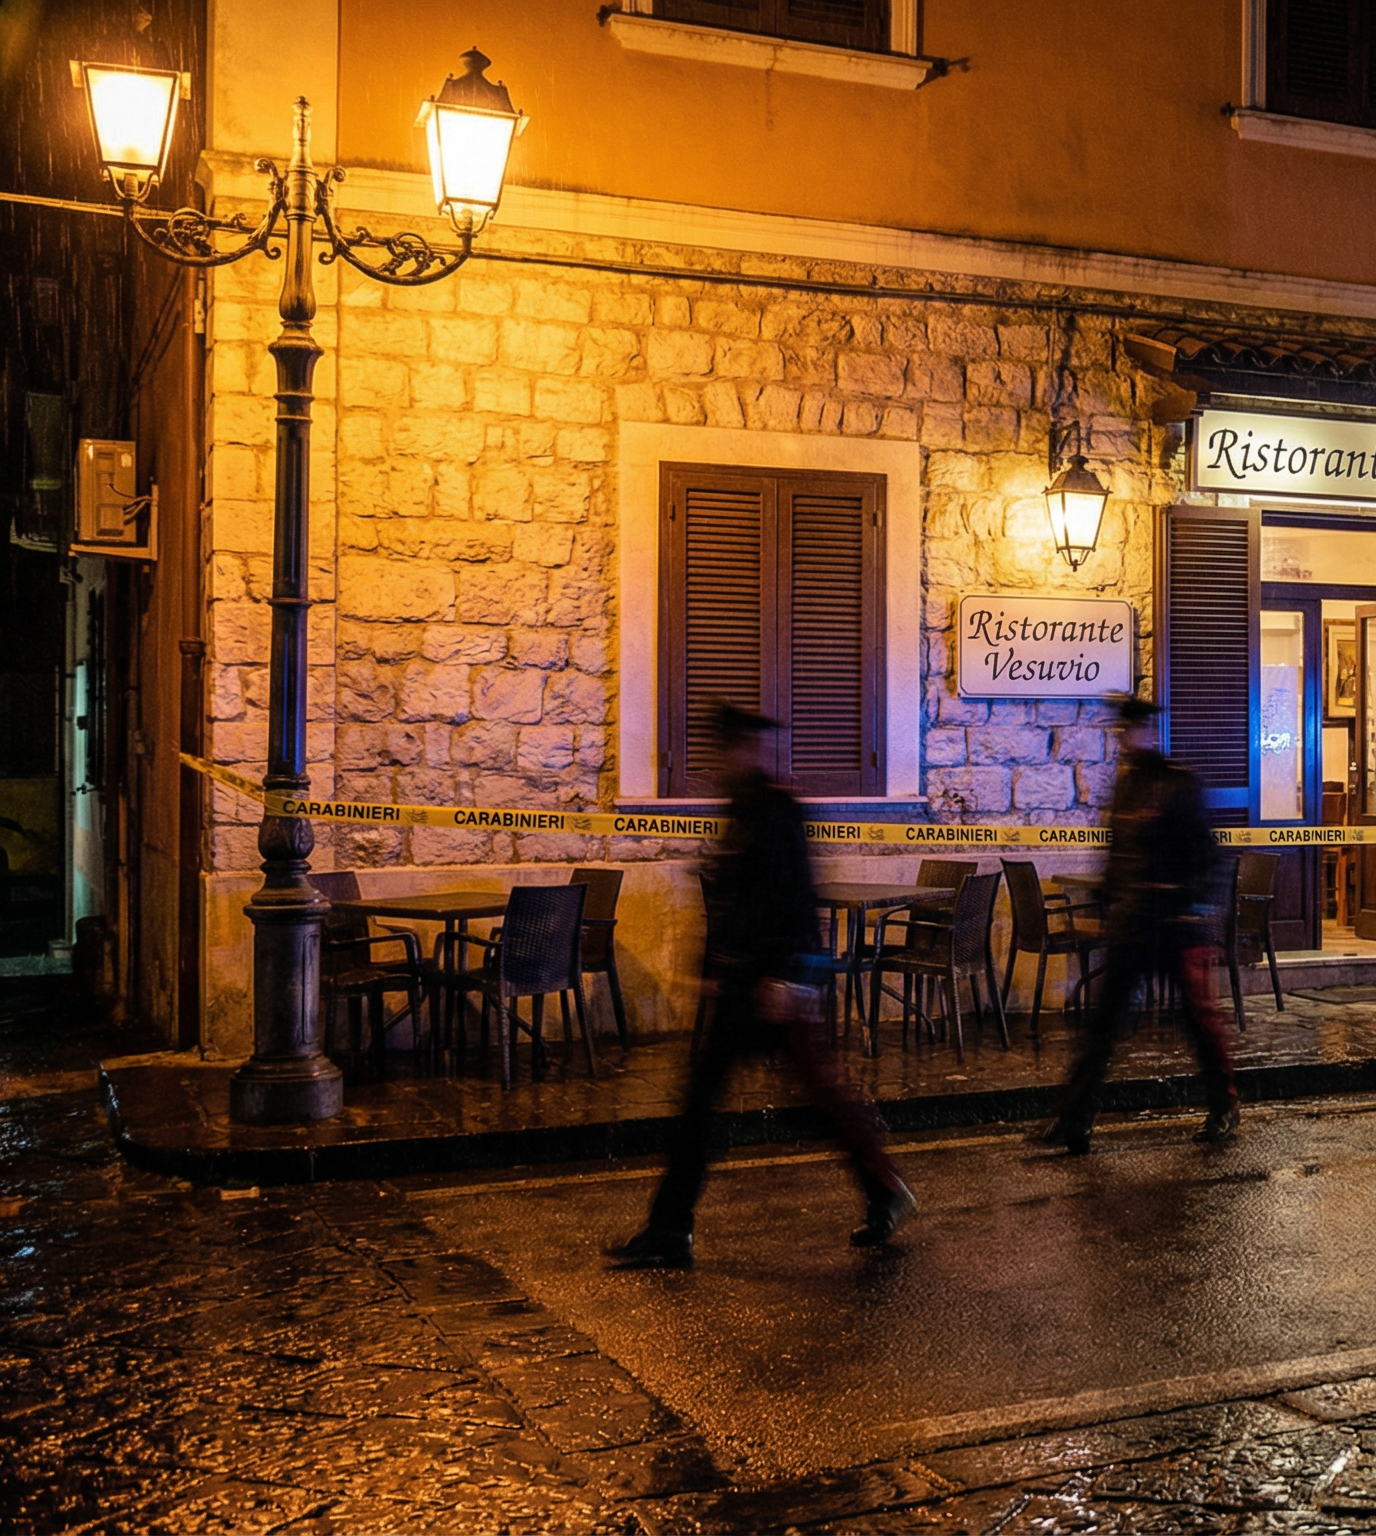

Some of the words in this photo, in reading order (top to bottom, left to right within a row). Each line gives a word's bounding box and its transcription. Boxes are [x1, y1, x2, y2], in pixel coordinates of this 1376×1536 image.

[967, 610, 1124, 647] Ristorante
[984, 647, 1100, 681] Vesuvio
[282, 800, 400, 820] CARABINIERI
[453, 810, 565, 829] CARABINIERI
[613, 817, 719, 835] CARABINIERI
[806, 824, 861, 839] BINIERI
[905, 827, 998, 842] CARABINIERI
[1039, 829, 1114, 843] CARABINIE
[1269, 829, 1346, 843] CARABINIERI
